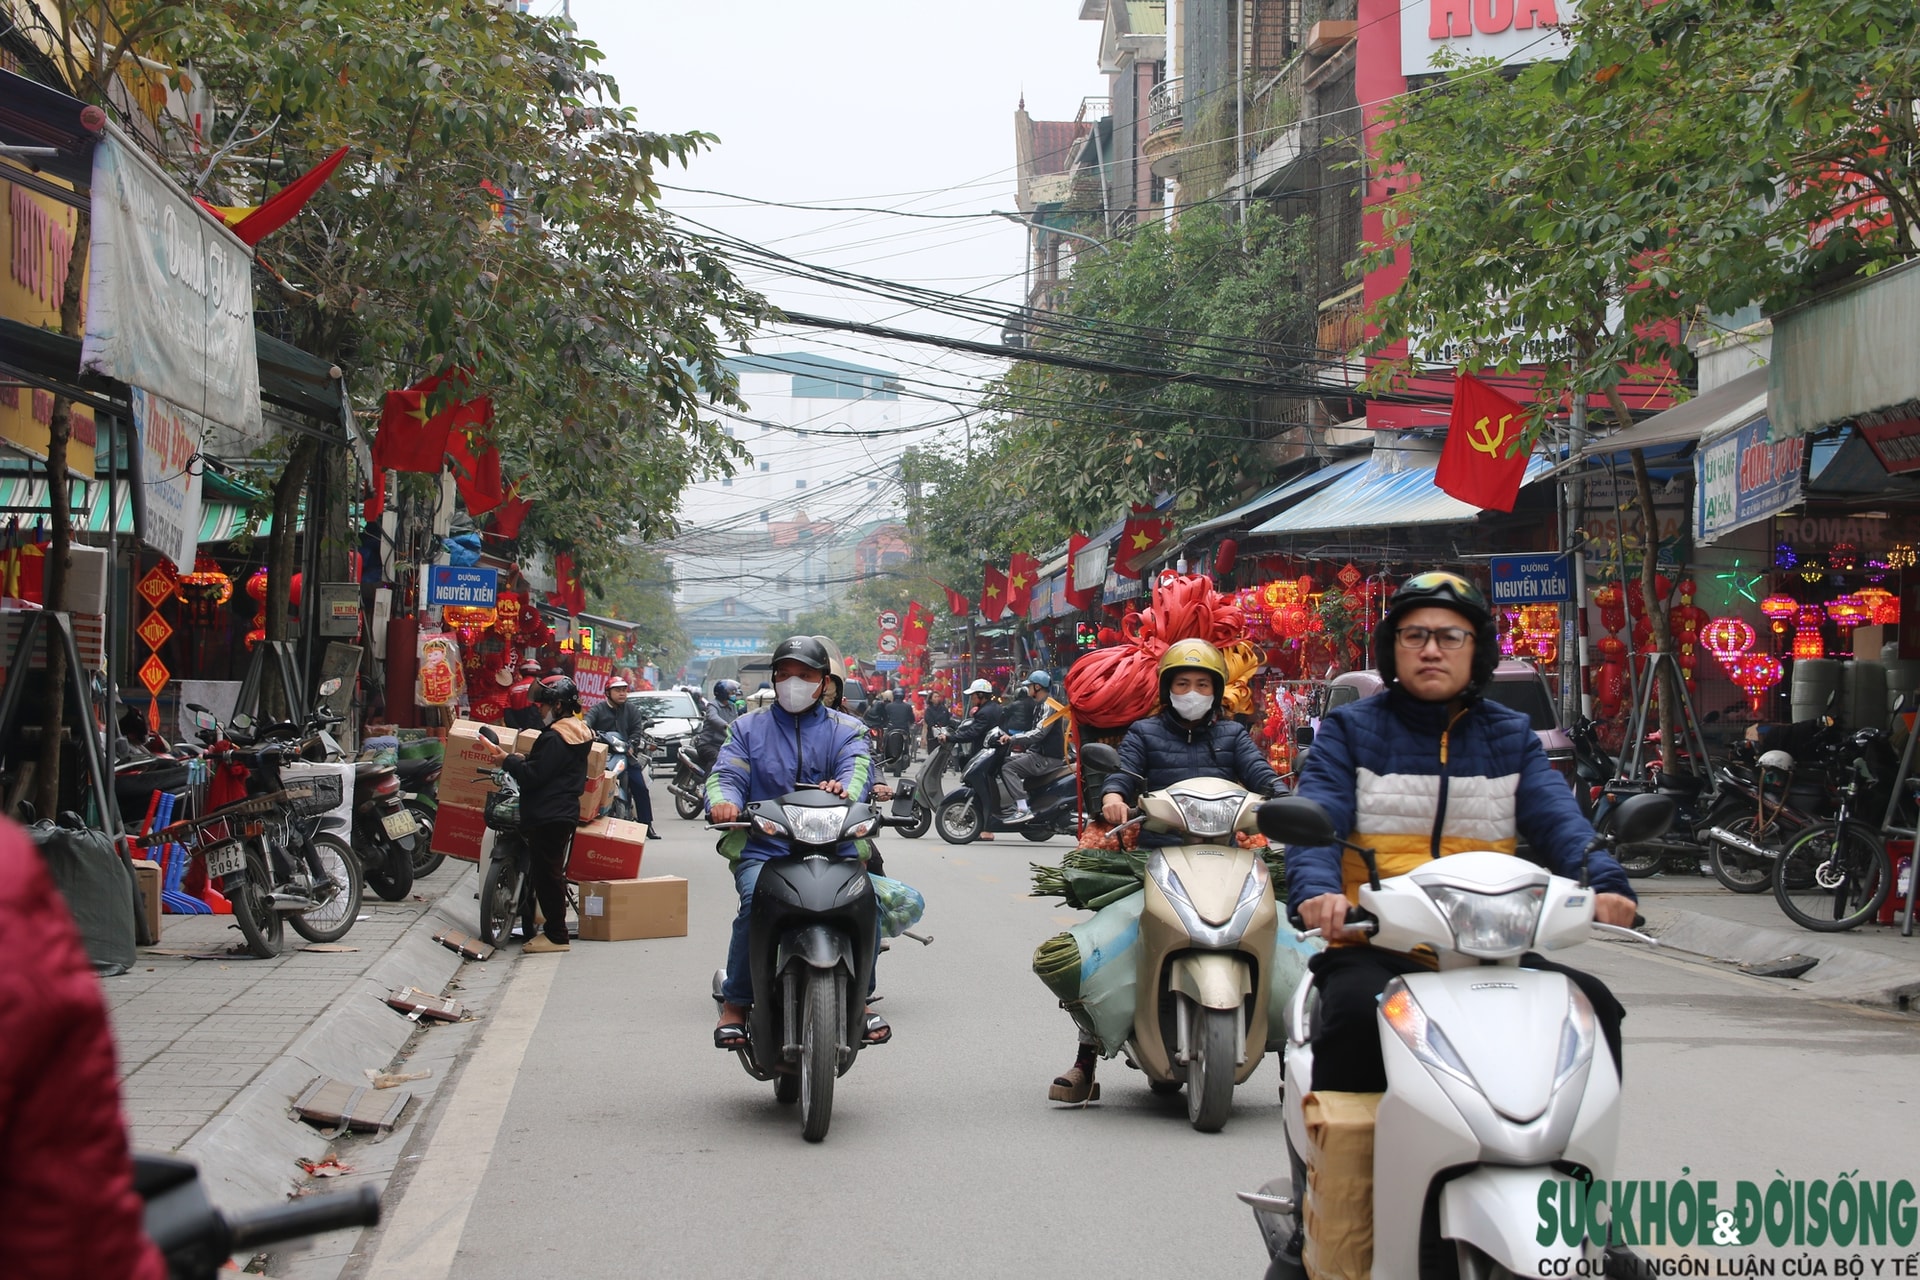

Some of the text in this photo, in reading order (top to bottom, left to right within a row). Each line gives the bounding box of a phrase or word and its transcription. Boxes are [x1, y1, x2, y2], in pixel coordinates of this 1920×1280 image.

[1520, 561, 1549, 573] ĐƯỜNG
[143, 574, 168, 597] CHÚC
[436, 582, 494, 603] NGUYỄN XIỂN
[1495, 571, 1566, 598] NGUYỄN XIỂN
[211, 858, 240, 877] 5094
